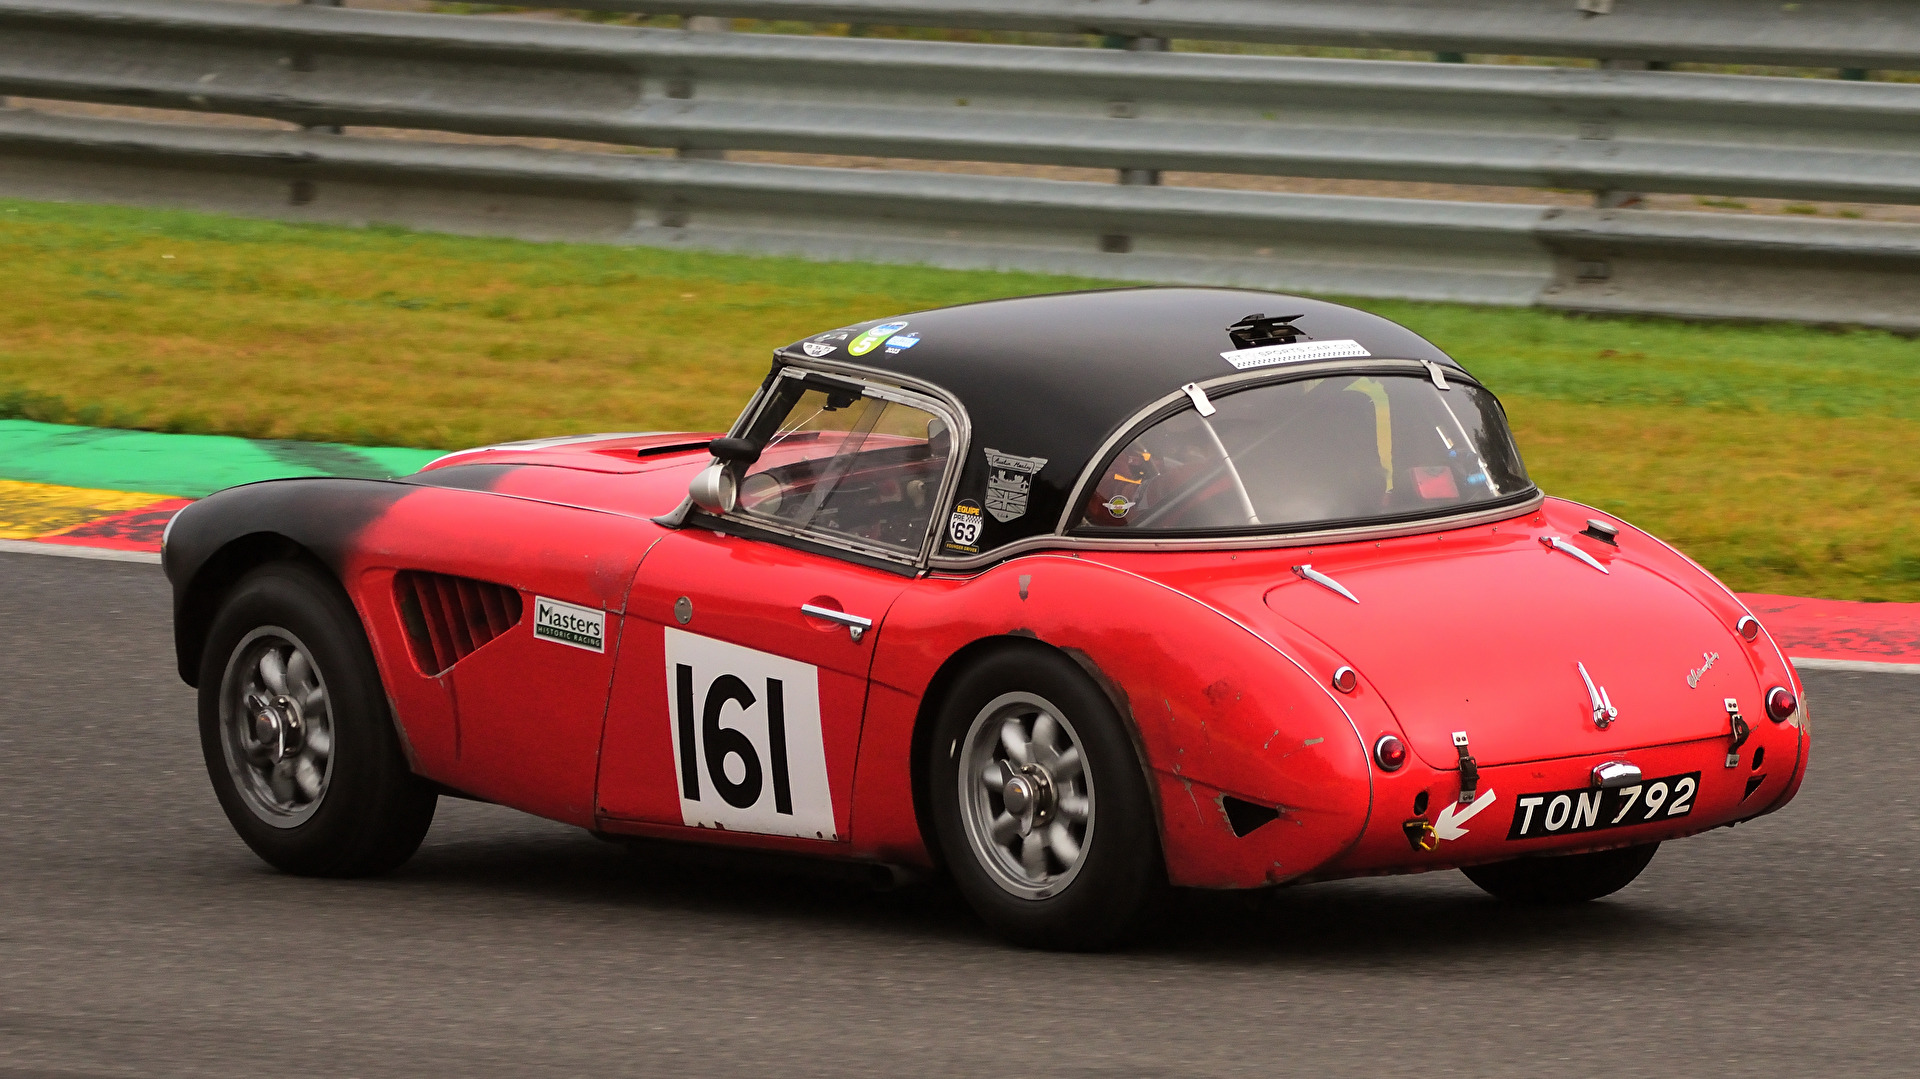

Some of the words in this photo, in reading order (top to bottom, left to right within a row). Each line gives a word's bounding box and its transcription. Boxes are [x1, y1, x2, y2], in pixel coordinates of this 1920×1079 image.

[853, 337, 878, 353] 5
[1258, 346, 1305, 357] SPORTS
[1307, 344, 1331, 352] CAR
[953, 513, 966, 522] PRE
[957, 505, 980, 516] EQUIPE
[539, 603, 600, 637] Masters
[538, 626, 571, 640] HISTORIC
[573, 634, 600, 647] RACING
[676, 663, 794, 815] 161
[1519, 790, 1603, 835] TON
[1611, 777, 1696, 824] 792
